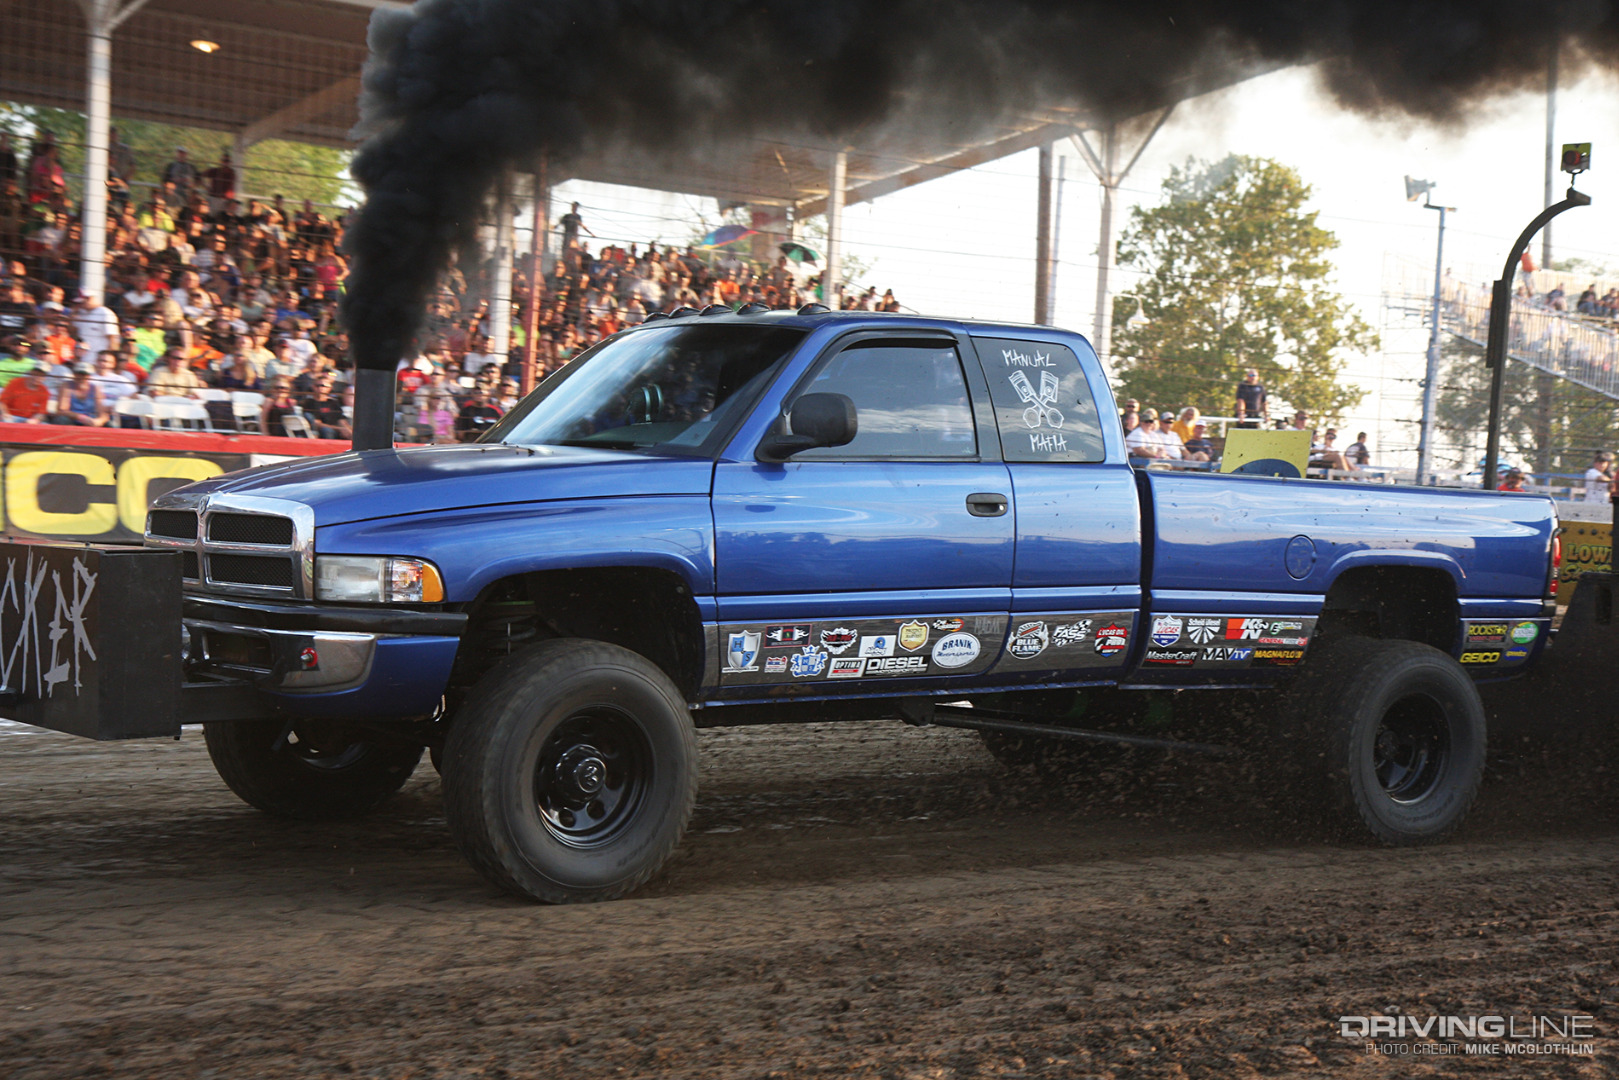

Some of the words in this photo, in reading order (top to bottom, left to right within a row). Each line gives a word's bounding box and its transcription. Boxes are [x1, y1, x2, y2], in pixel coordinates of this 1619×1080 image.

[1001, 349, 1057, 368] MANUAL
[1029, 433, 1068, 453] MAFIA
[0, 451, 225, 536] CO
[1053, 626, 1087, 640] FASS
[1156, 626, 1180, 634] LUCAS
[942, 639, 973, 651] BRANIK
[1016, 638, 1040, 646] BLUE
[1145, 650, 1198, 661] MasterCraft
[1460, 652, 1501, 664] GEICO
[834, 660, 862, 669] OPTIMA
[866, 656, 928, 670] DIESEL
